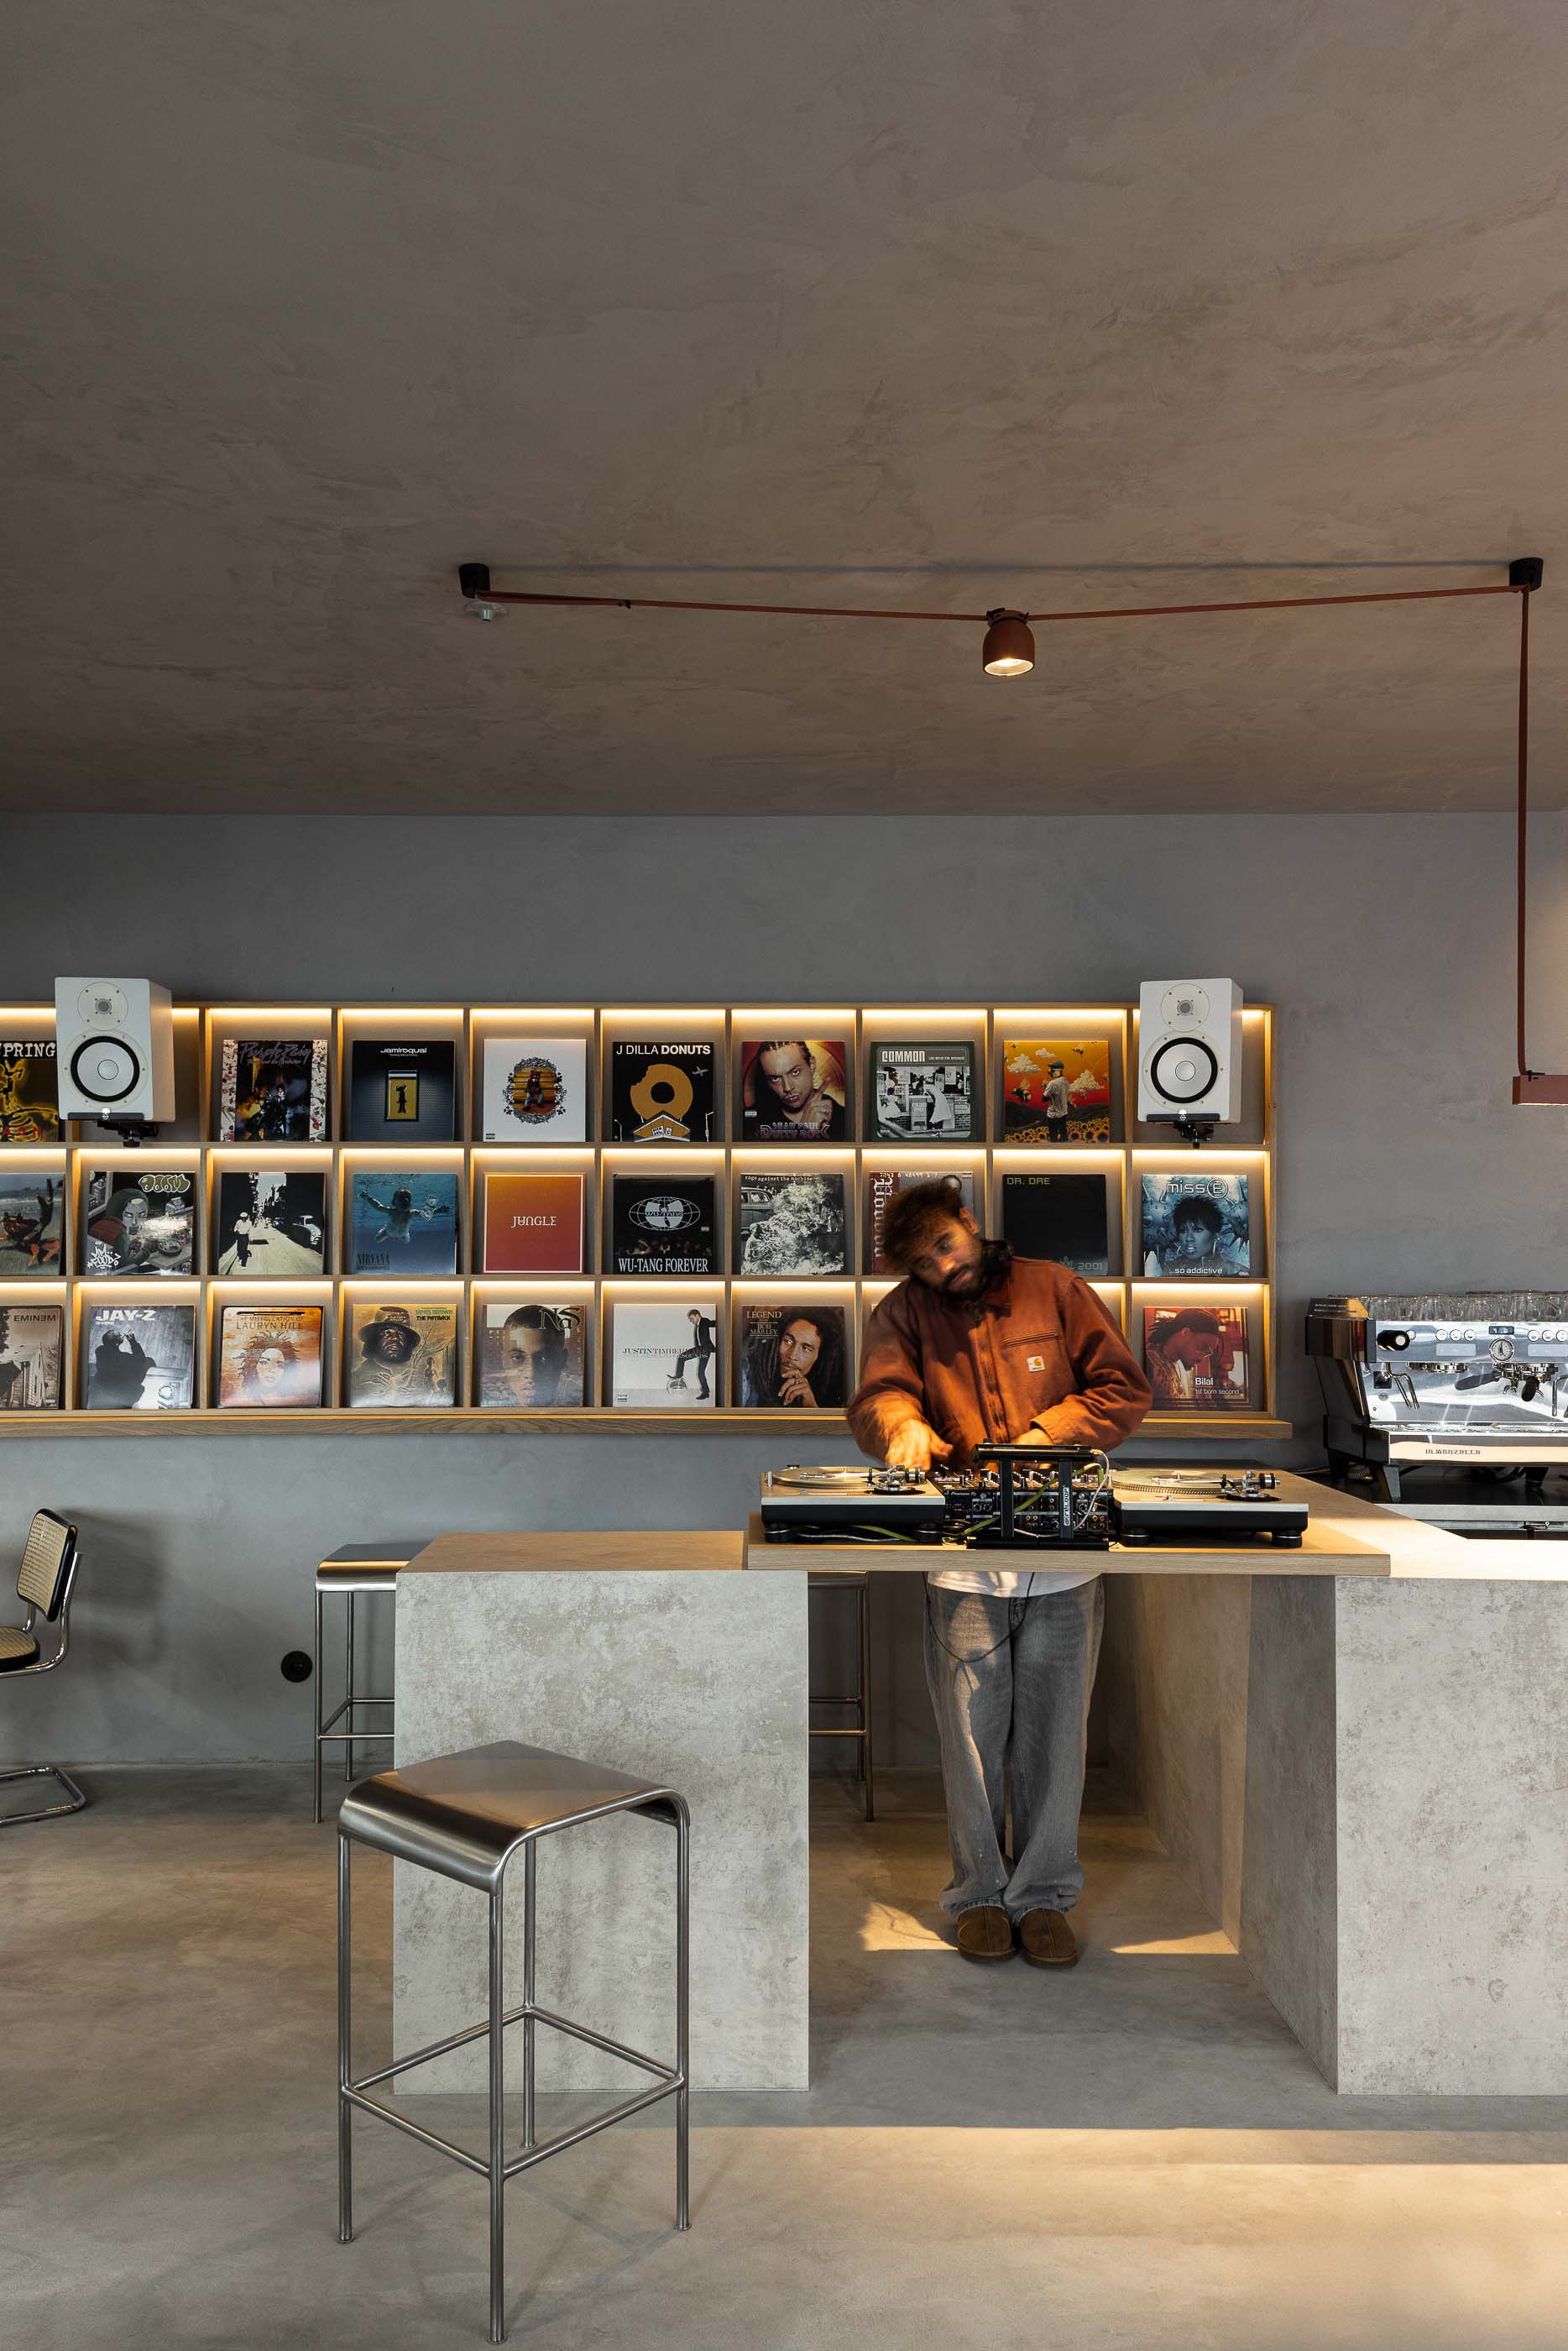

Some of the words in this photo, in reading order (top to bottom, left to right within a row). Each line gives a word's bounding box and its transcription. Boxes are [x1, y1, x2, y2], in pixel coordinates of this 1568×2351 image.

[0, 1042, 56, 1057] PRING
[616, 1045, 623, 1055] J
[626, 1045, 659, 1055] DILLA
[661, 1045, 711, 1055] DONUTS
[881, 1050, 926, 1062] COMMON
[1167, 1180, 1205, 1194] miss
[510, 1216, 557, 1228] JUNGLE
[357, 1254, 389, 1265] NIRVANA
[618, 1258, 663, 1272] WU-TANG
[665, 1258, 708, 1272] FOREVER
[1078, 1262, 1102, 1270] 2001
[96, 1310, 157, 1322] JAY-Z
[1194, 1377, 1214, 1385] Bilal
